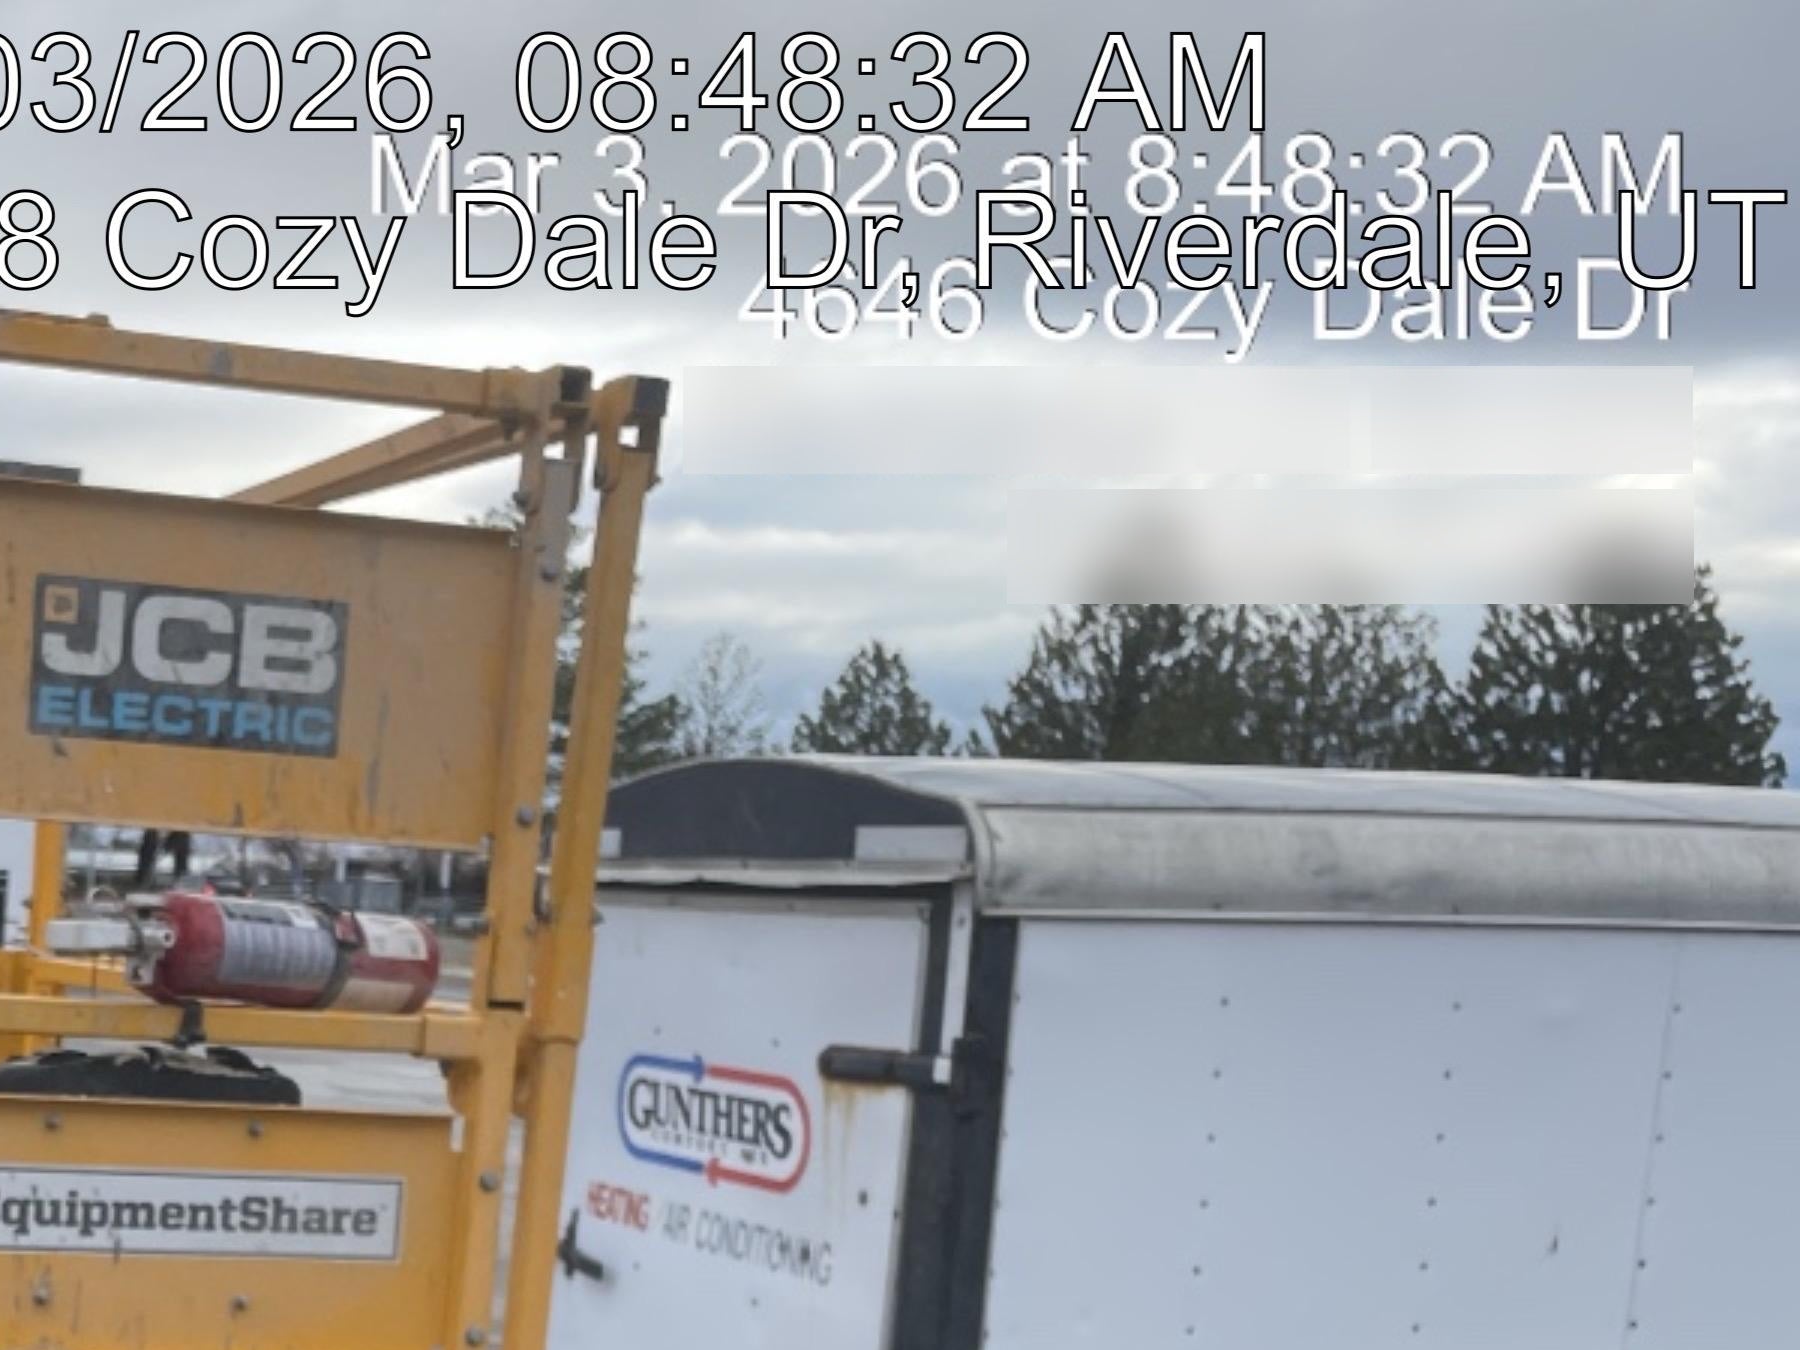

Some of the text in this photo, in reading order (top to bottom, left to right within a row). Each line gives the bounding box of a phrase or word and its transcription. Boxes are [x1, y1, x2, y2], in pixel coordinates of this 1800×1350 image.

[39, 588, 339, 696] JCB
[36, 685, 335, 747] ELECTRIC
[628, 1076, 794, 1161] GUNTHERS
[587, 1180, 650, 1232] HEATING
[694, 1209, 833, 1287] CONDITIONING
